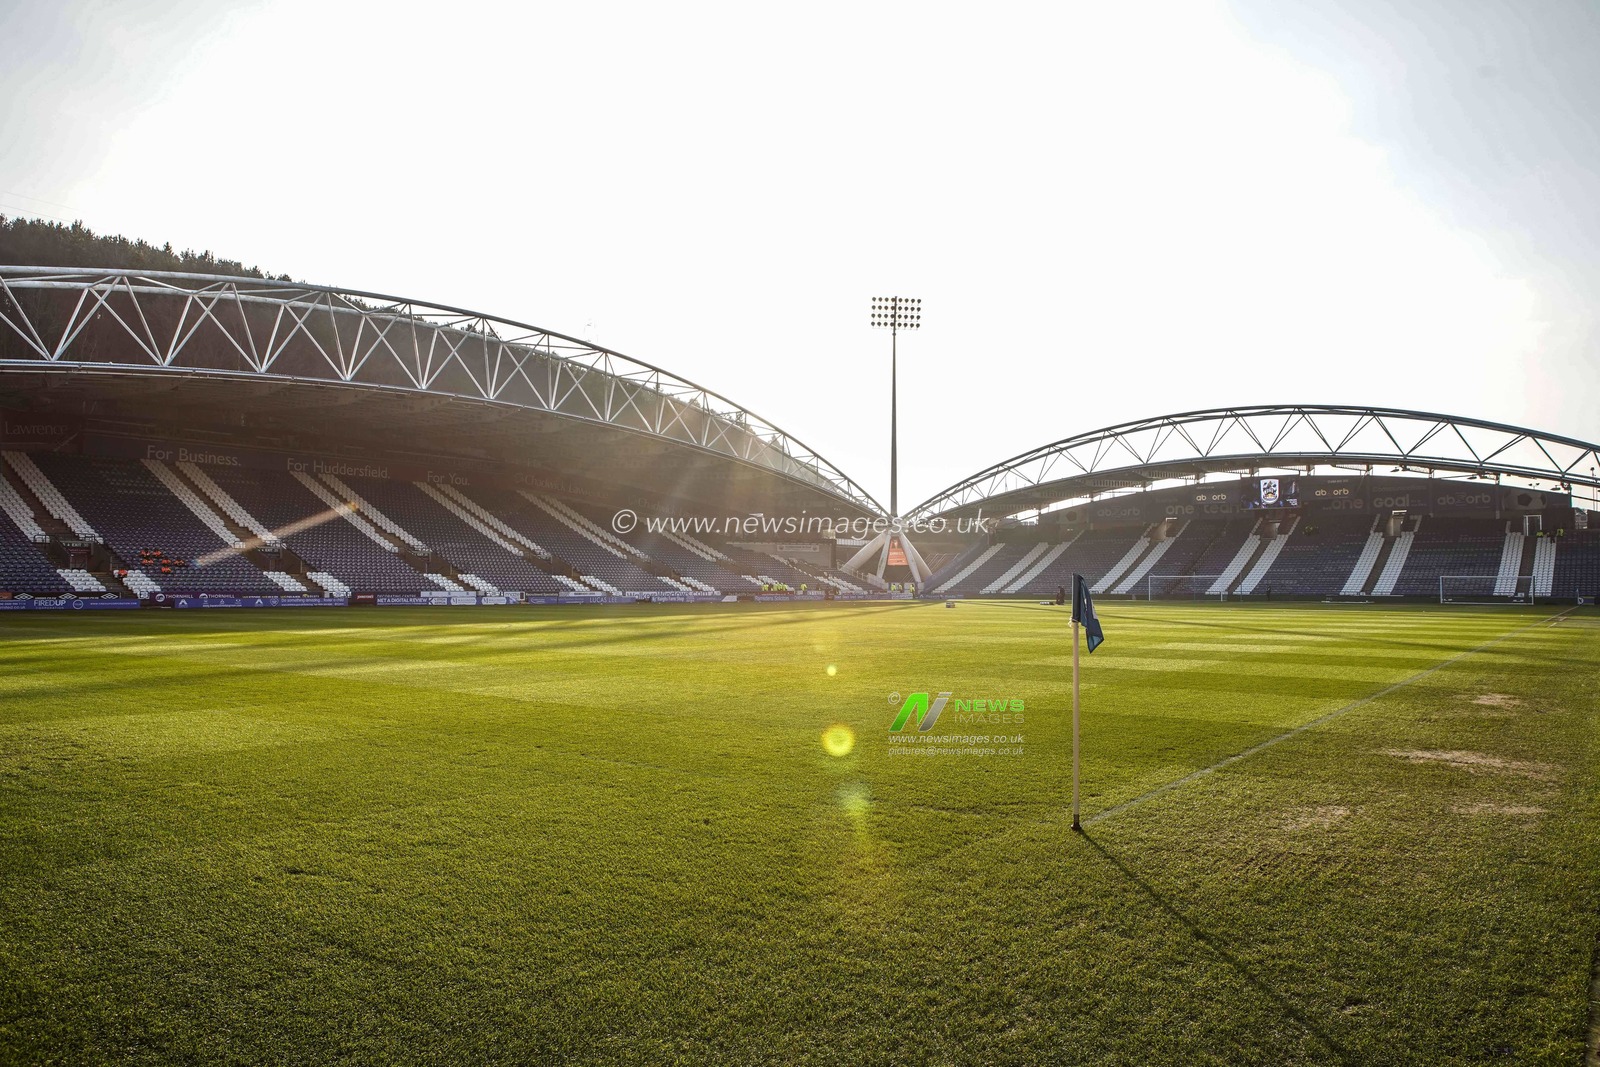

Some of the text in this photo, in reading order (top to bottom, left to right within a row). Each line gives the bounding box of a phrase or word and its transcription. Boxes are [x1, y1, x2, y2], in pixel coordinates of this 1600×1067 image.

[147, 445, 242, 466] For Business.
[287, 458, 391, 480] For Huddersfield.
[427, 471, 470, 486] For You.
